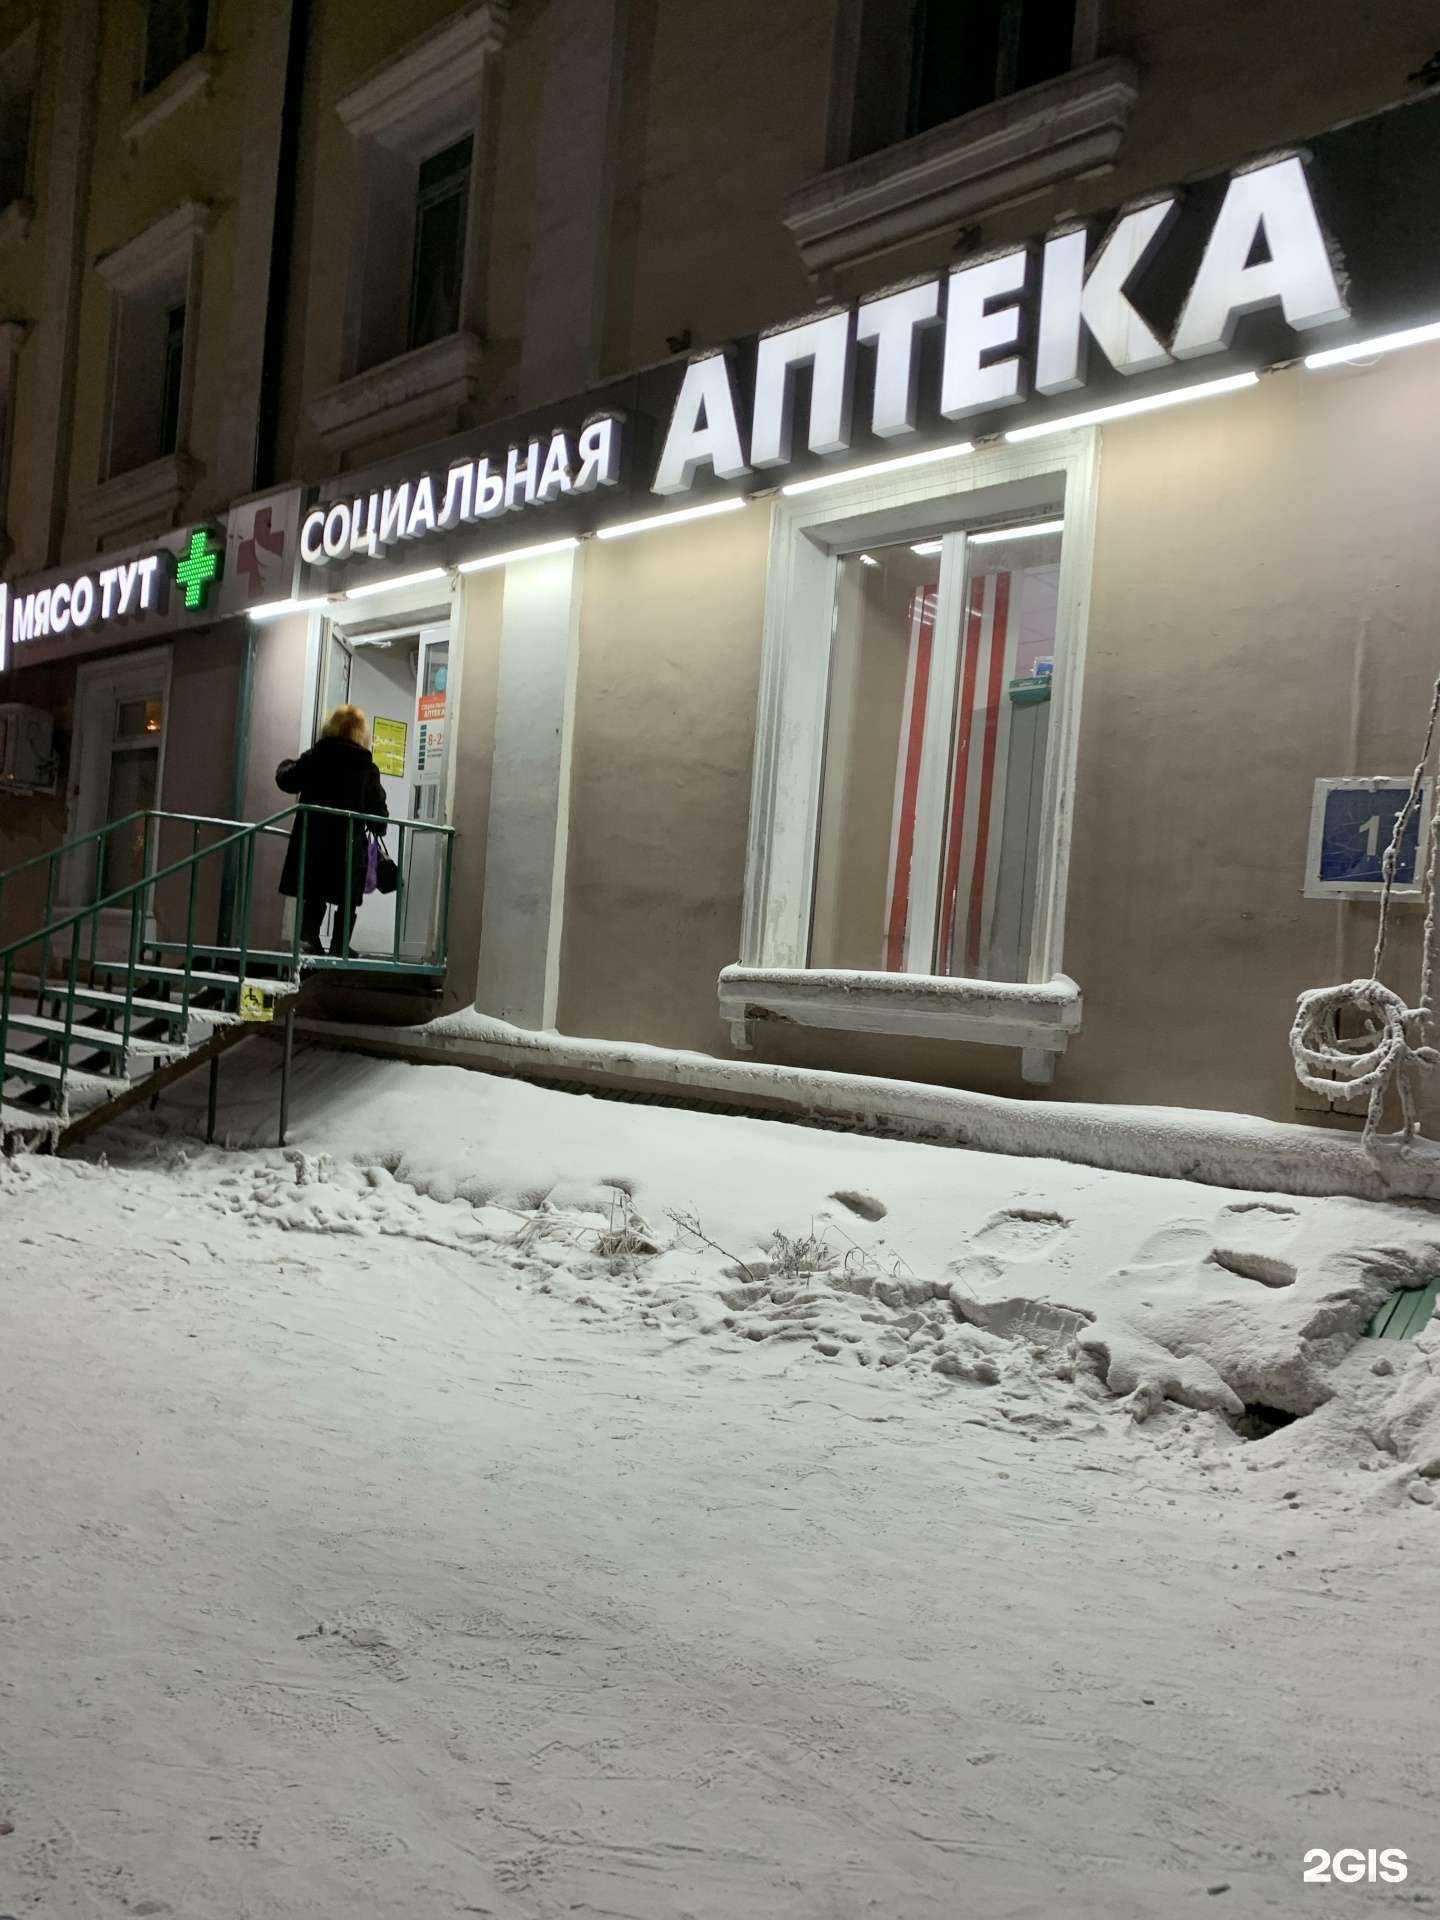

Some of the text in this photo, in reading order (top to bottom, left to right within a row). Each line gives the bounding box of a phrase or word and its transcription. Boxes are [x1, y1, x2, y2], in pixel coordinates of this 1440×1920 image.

[301, 156, 1349, 566] СОЦИАЛЬНАЯ АПТЕКА
[12, 575, 94, 643] МЯСО
[99, 555, 158, 619] ТУТ
[1358, 815, 1380, 857] 1
